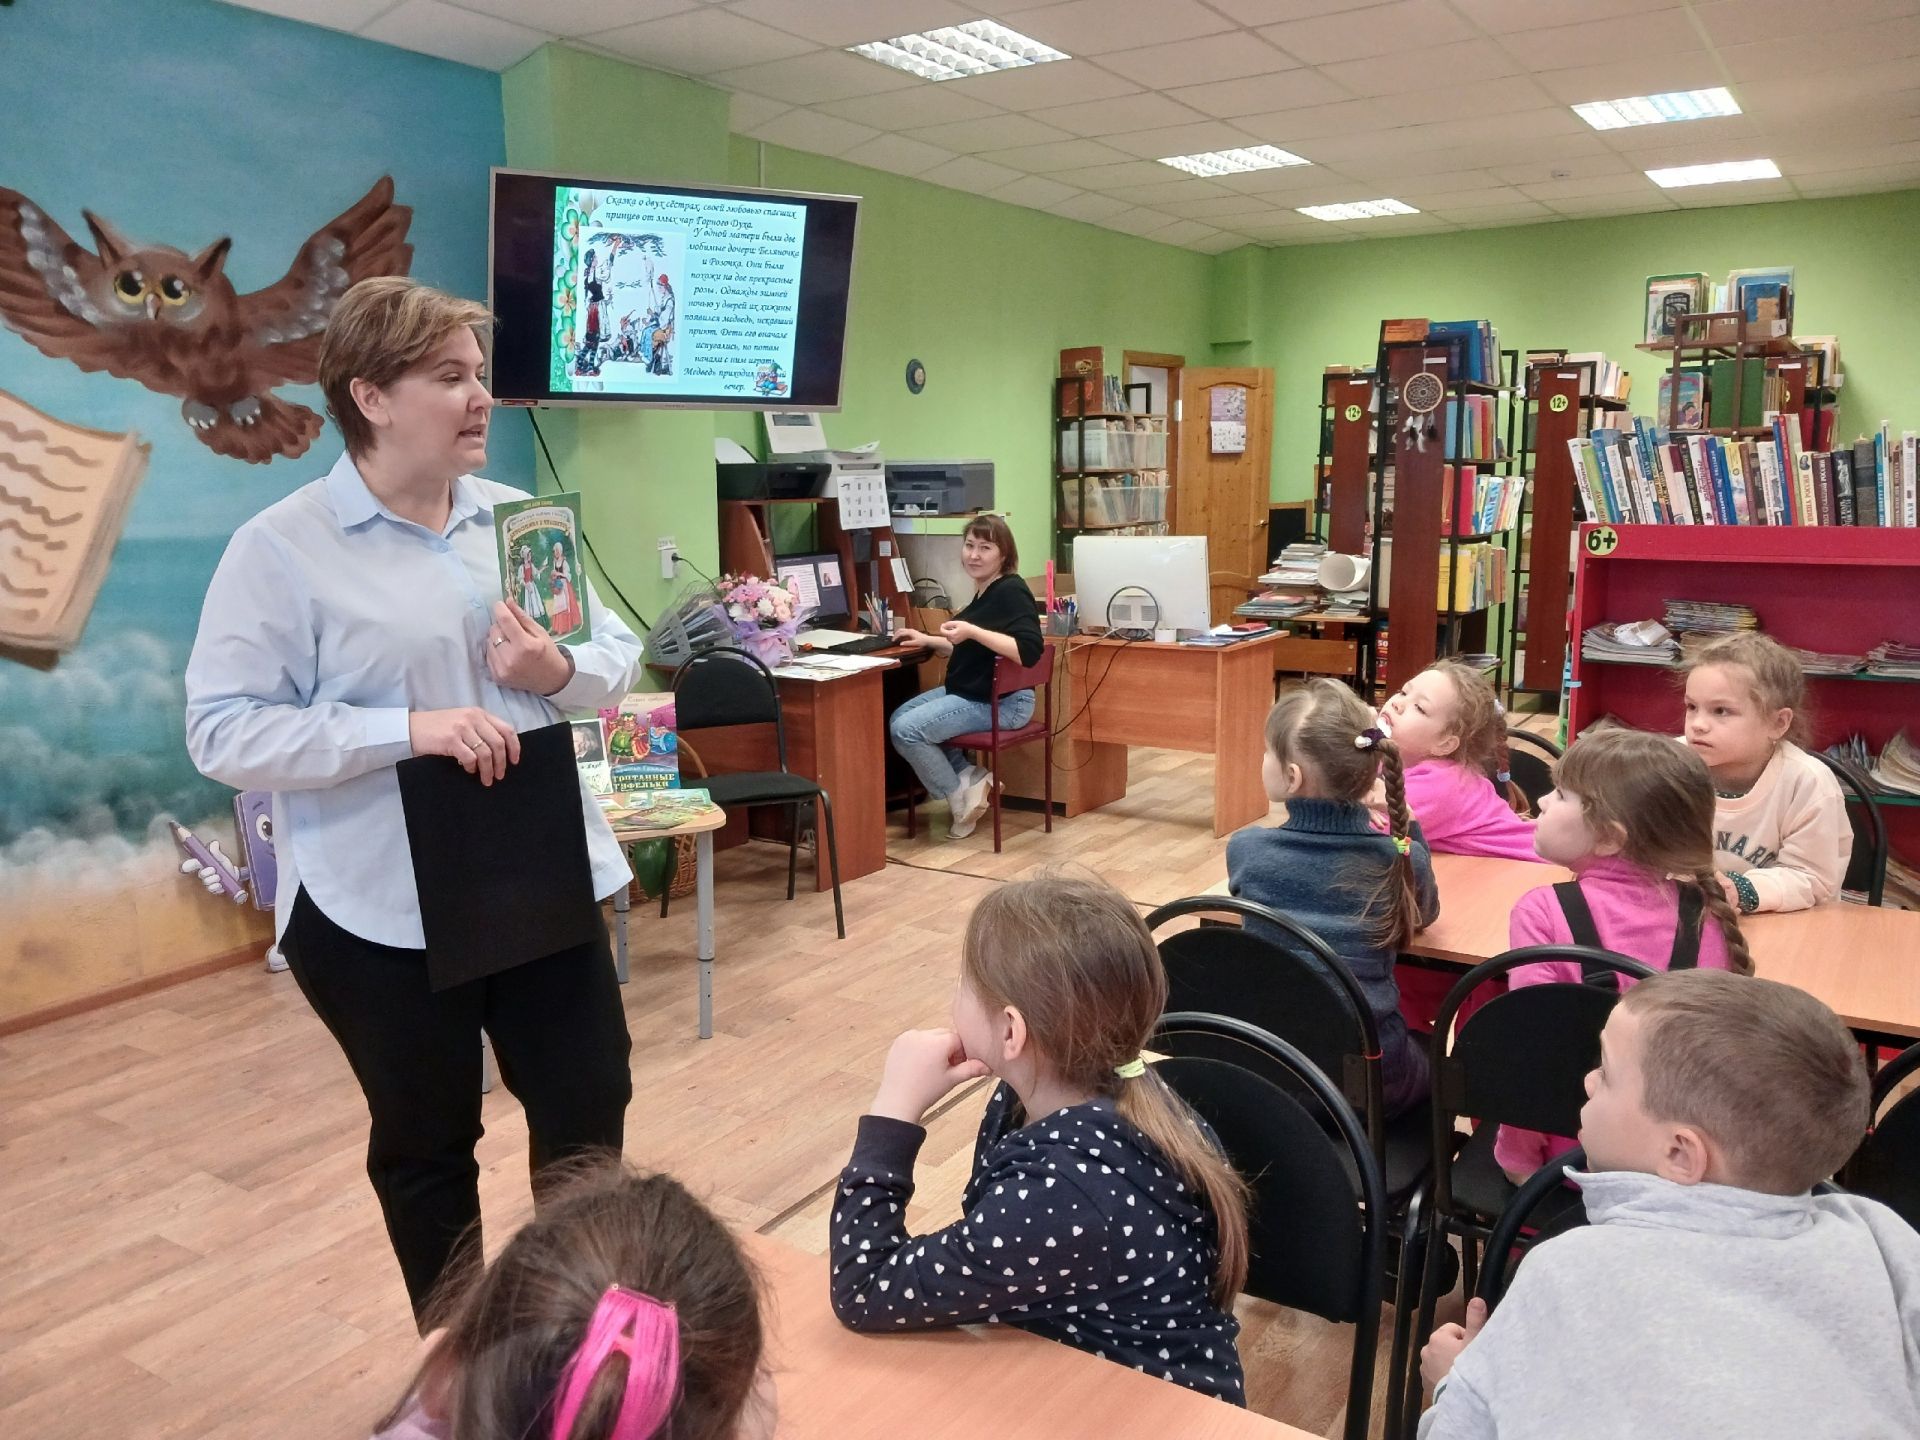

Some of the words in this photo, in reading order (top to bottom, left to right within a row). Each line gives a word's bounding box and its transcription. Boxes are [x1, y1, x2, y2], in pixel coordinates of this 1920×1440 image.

[605, 195, 637, 206] Сказка
[645, 197, 665, 210] двух
[703, 204, 725, 212] своей
[726, 205, 762, 214] любовью
[605, 212, 640, 221] принцев
[656, 215, 678, 224] злых
[679, 217, 694, 226] чар
[696, 217, 729, 229] Горного
[693, 227, 702, 238] У
[704, 228, 727, 238] одной
[729, 232, 760, 243] матери
[762, 231, 782, 241] были
[783, 233, 796, 243] две
[746, 260, 764, 268] Они
[764, 260, 784, 270] были
[690, 272, 721, 282] похожи
[723, 273, 733, 281] на
[734, 272, 747, 282] две
[749, 276, 794, 285] прекрасные
[720, 286, 758, 297] Однажды
[714, 301, 720, 310] у
[722, 300, 747, 311] дверей
[749, 303, 759, 312] их
[684, 314, 720, 322] появился
[720, 328, 743, 337] Дети
[753, 344, 780, 352] потом
[683, 366, 716, 376] Медведь
[1552, 397, 1567, 409] 12+
[1348, 407, 1360, 418] 12+
[1588, 528, 1616, 551] 6+
